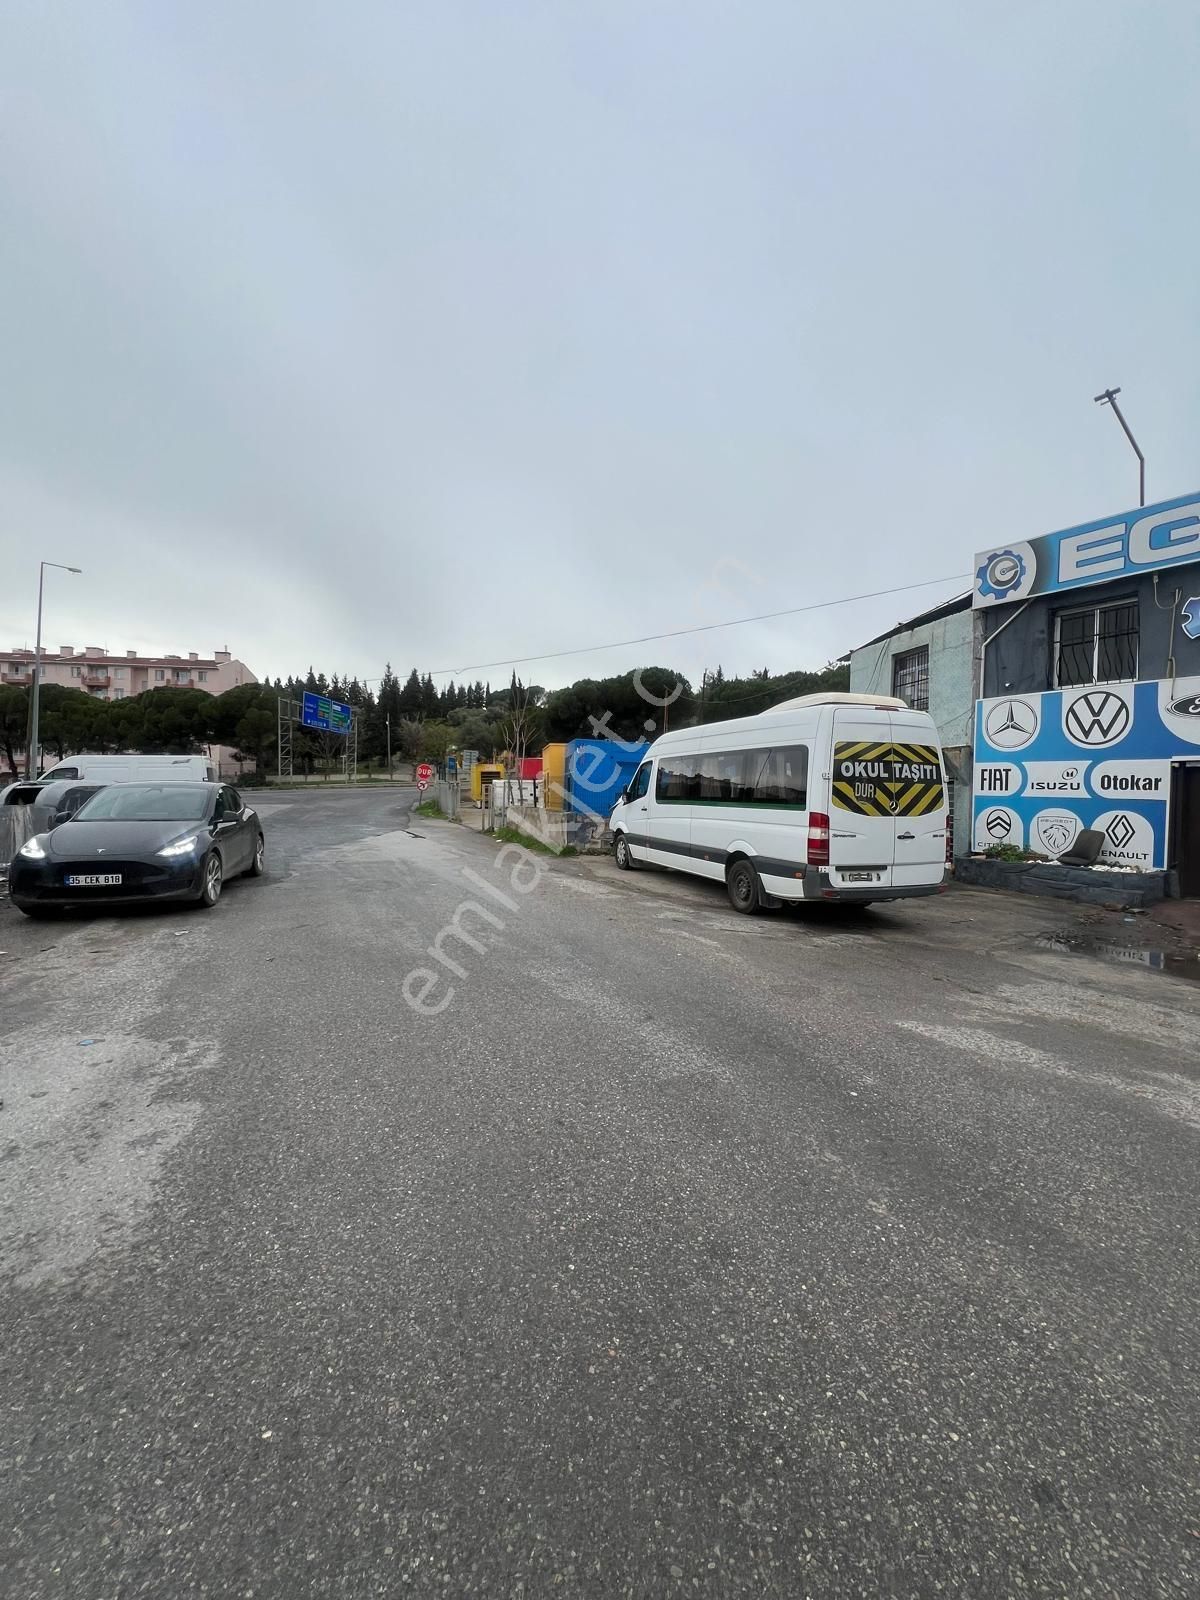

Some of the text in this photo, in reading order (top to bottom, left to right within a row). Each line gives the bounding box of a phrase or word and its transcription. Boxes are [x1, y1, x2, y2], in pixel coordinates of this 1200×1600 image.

[417, 767, 432, 775] DUR
[840, 761, 937, 782] OKUL TAŞITI
[980, 768, 1011, 791] FIAT
[1031, 782, 1080, 790] ISUZU
[1100, 774, 1162, 791] Otokar
[855, 781, 875, 798] DUR
[1100, 850, 1149, 860] ENAULT
[70, 876, 80, 884] 35
[84, 876, 100, 884] CEK
